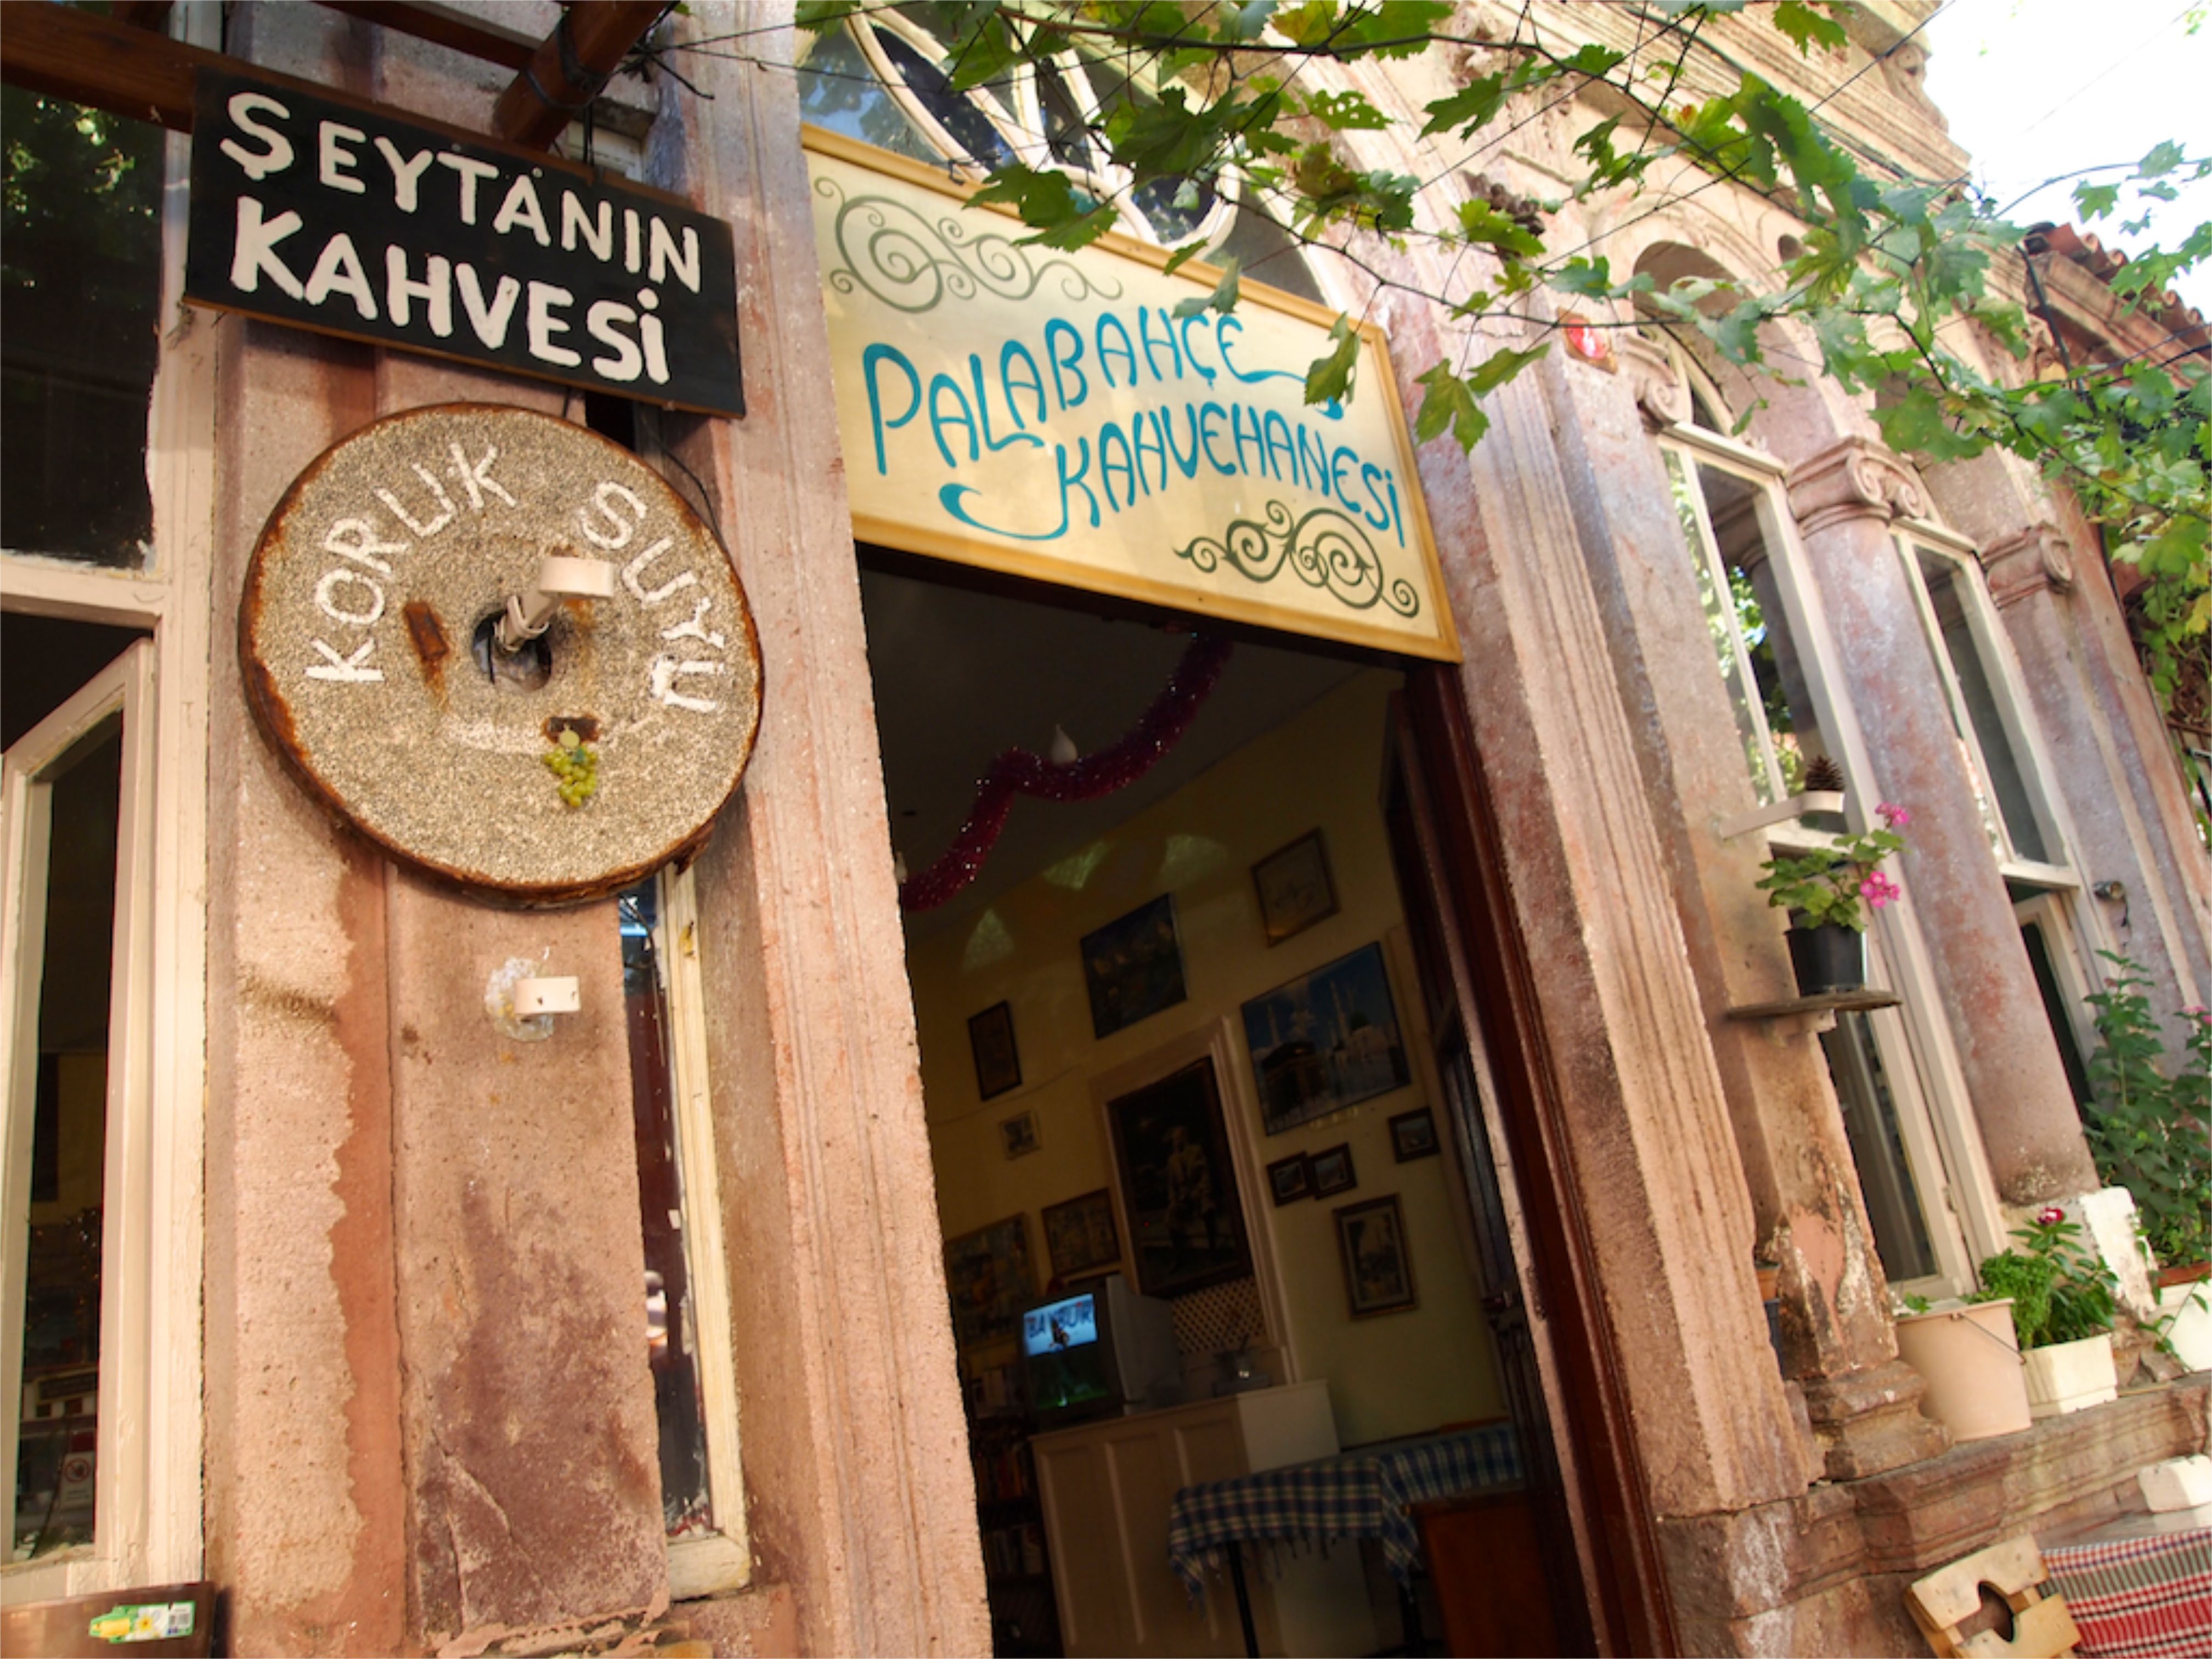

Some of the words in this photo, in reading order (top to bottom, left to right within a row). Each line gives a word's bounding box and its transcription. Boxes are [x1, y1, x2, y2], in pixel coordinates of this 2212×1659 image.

[219, 92, 701, 294] ŞEYTANIN
[230, 196, 670, 386] KAHVESİ
[862, 306, 1344, 476] PALABAHÇE
[938, 402, 1406, 548] KAHVEHANESİ
[306, 441, 517, 682] KORUK
